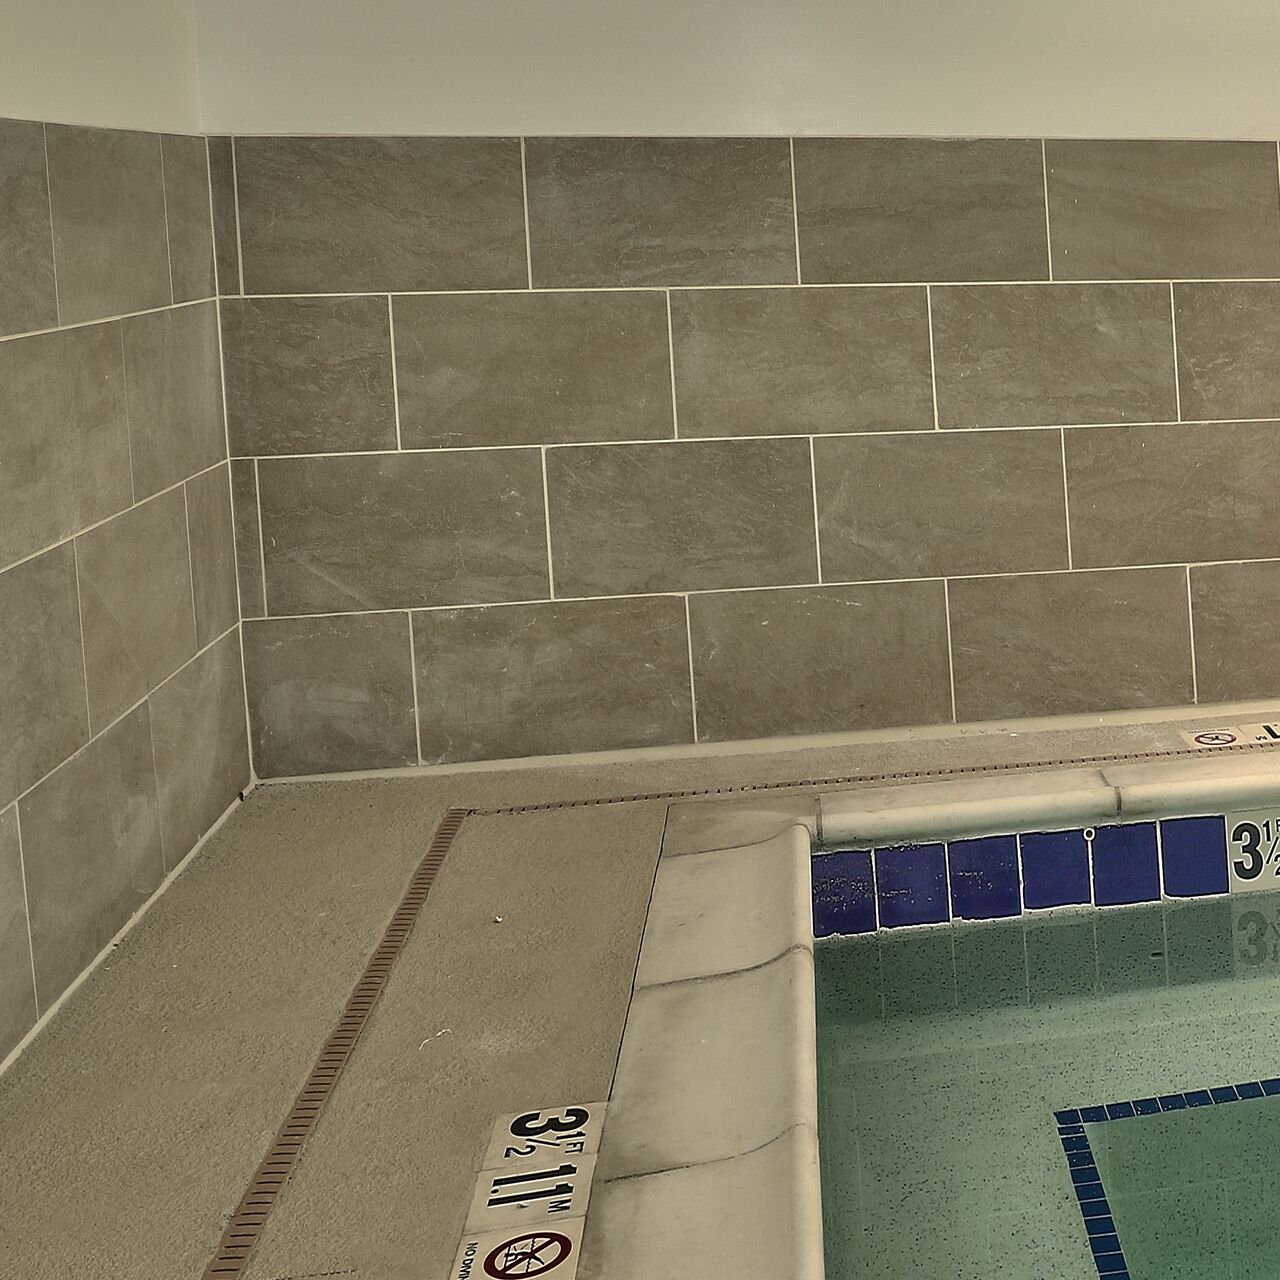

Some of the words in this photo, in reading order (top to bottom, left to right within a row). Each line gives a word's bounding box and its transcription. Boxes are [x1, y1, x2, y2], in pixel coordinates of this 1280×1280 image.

[564, 1140, 585, 1155] FT
[487, 1163, 577, 1208] 1.1
[547, 1198, 572, 1214] M
[466, 1241, 479, 1257] NO
